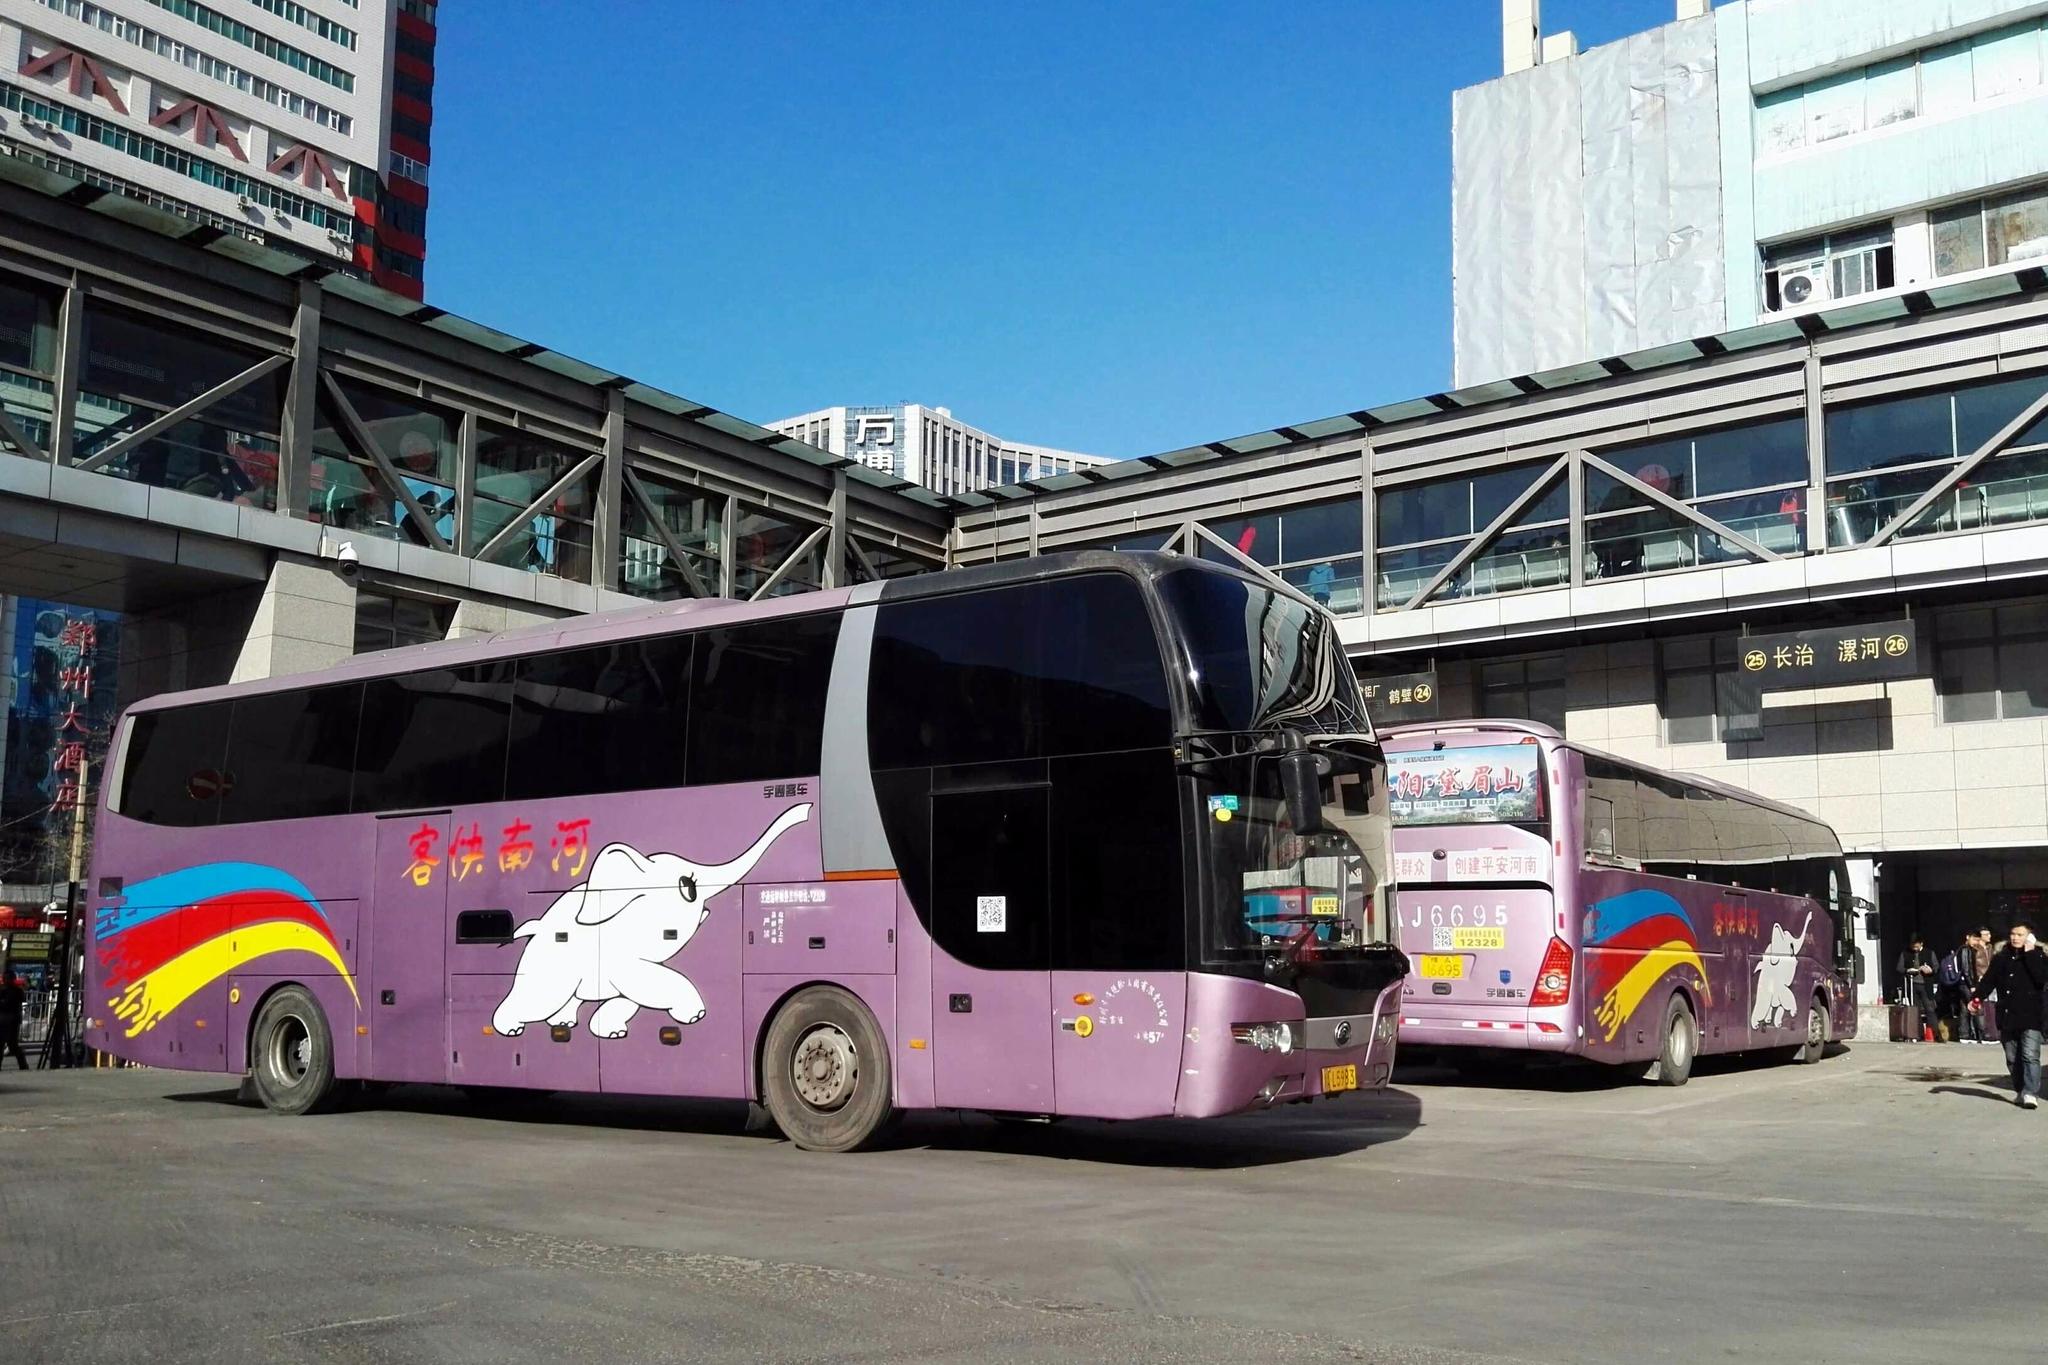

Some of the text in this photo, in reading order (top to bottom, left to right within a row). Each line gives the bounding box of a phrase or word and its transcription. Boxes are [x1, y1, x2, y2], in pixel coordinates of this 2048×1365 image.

[1773, 643, 1814, 668] 长治
[1838, 637, 1881, 662] 漯河
[1389, 688, 1412, 704] 鹤壁
[1455, 856, 1537, 875] 创建平安河南
[1460, 938, 1498, 947] 12328
